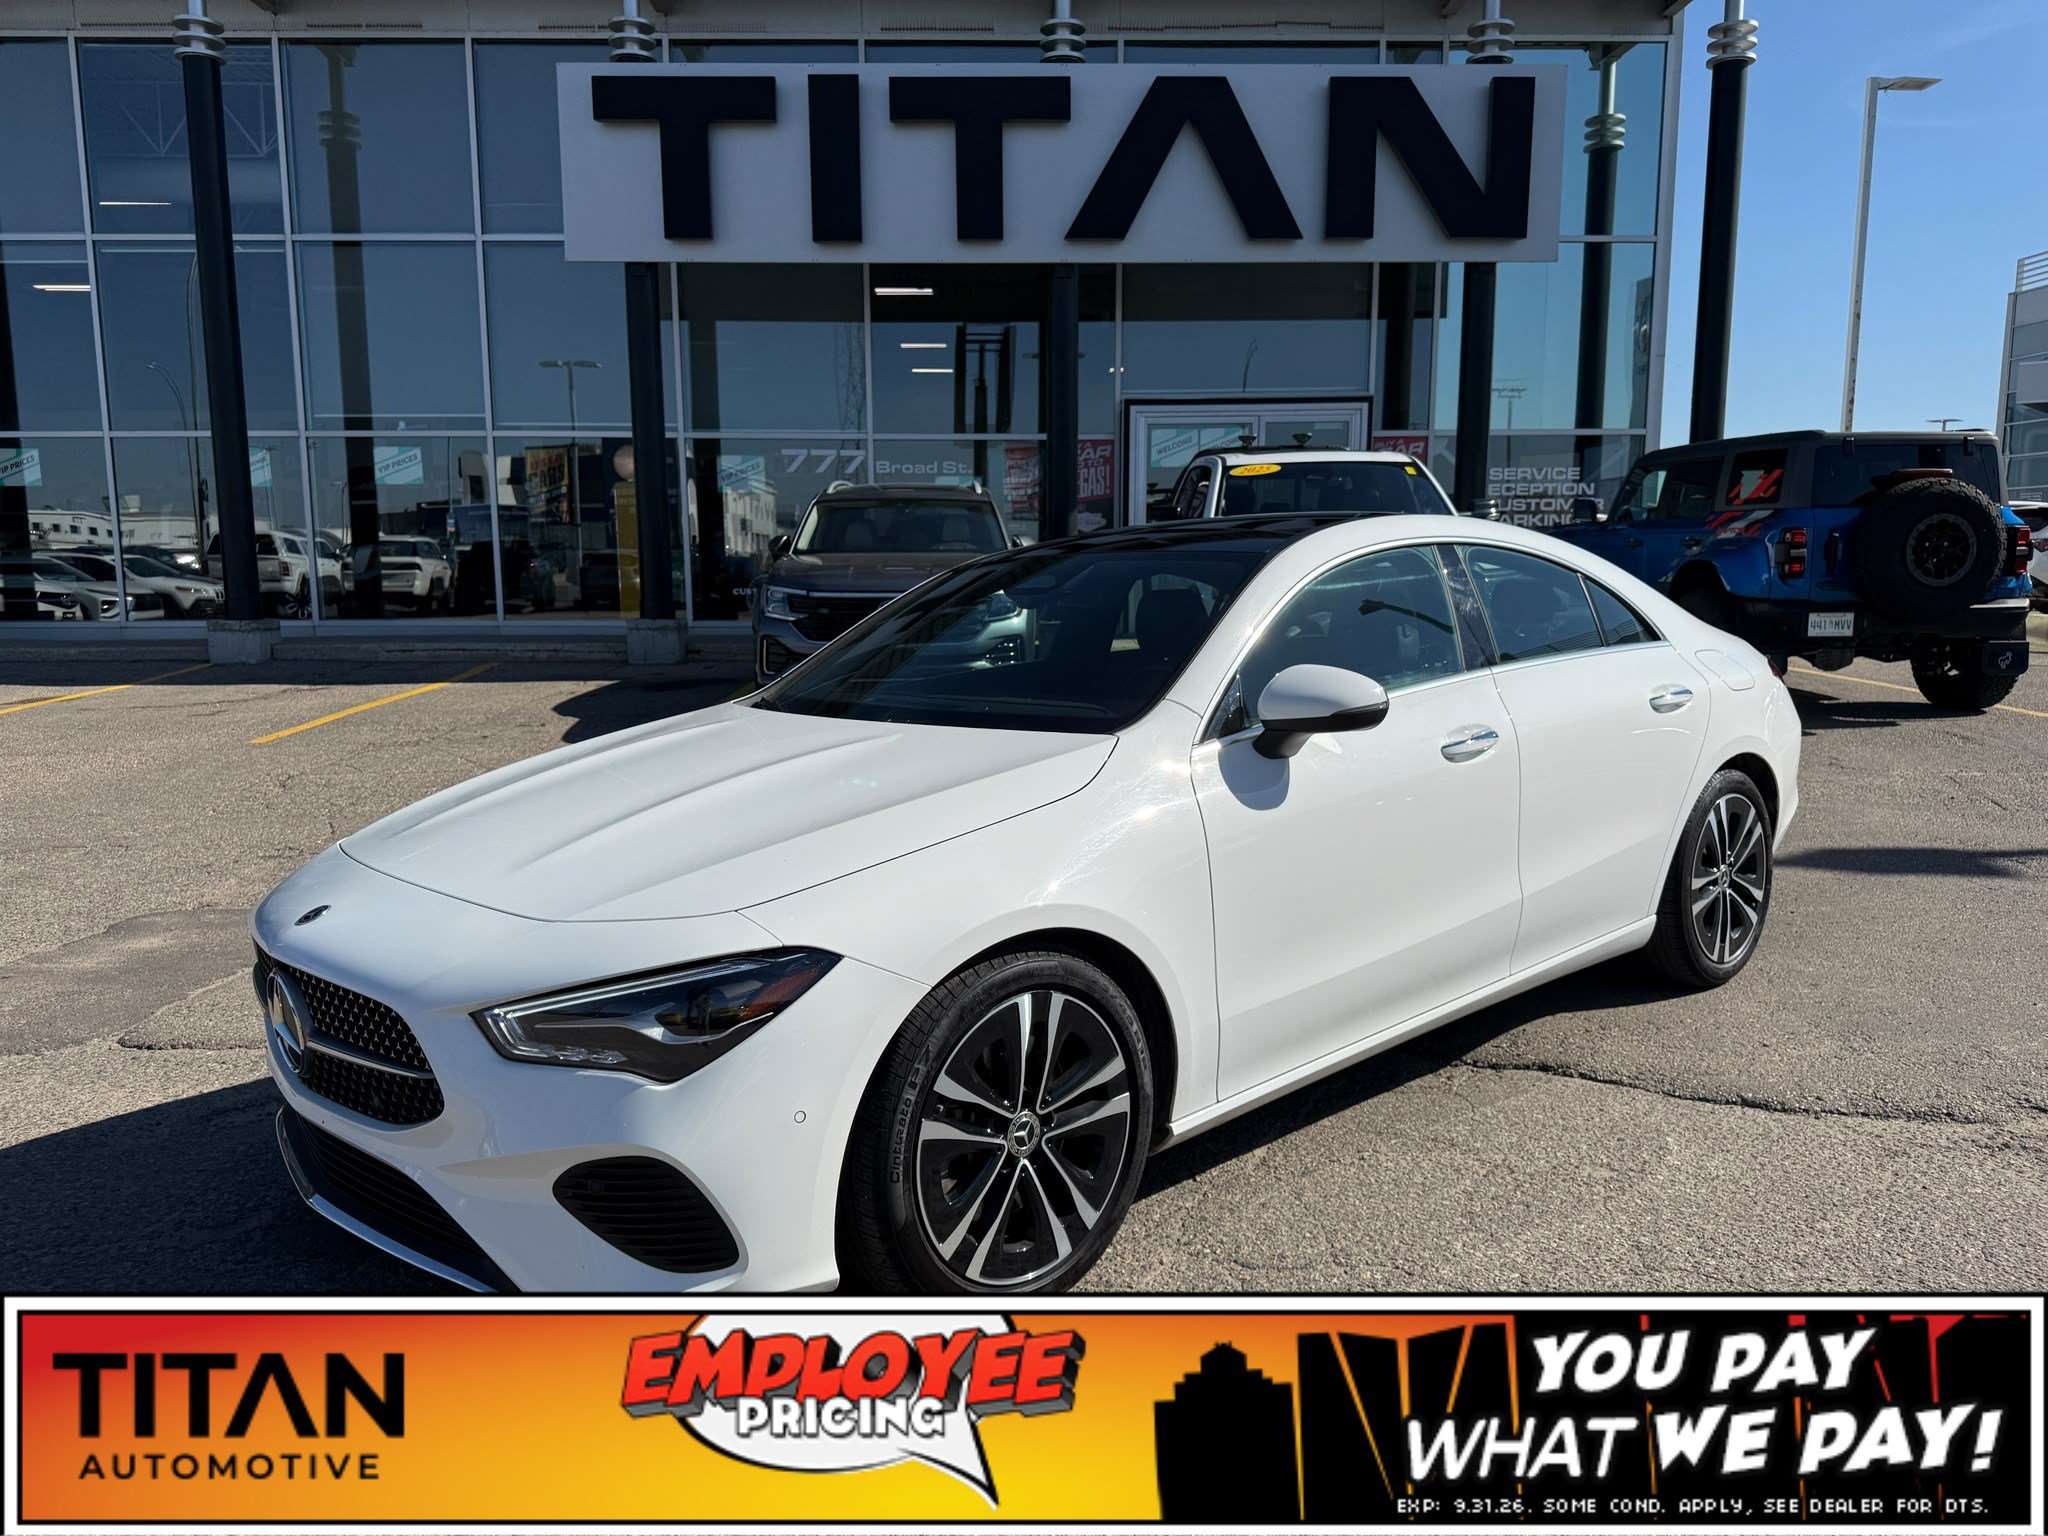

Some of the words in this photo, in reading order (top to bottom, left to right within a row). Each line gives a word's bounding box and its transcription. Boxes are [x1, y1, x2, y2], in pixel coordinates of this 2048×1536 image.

[592, 74, 1536, 242] TITAN
[1155, 434, 1194, 456] WELCOME
[391, 452, 418, 469] PRICES
[781, 449, 866, 473] 777
[876, 461, 938, 474] Broad
[942, 461, 974, 474] St.
[1489, 467, 1581, 480] SERVICE
[1487, 483, 1595, 496] ECEPTION
[1500, 513, 1574, 527] ARKING
